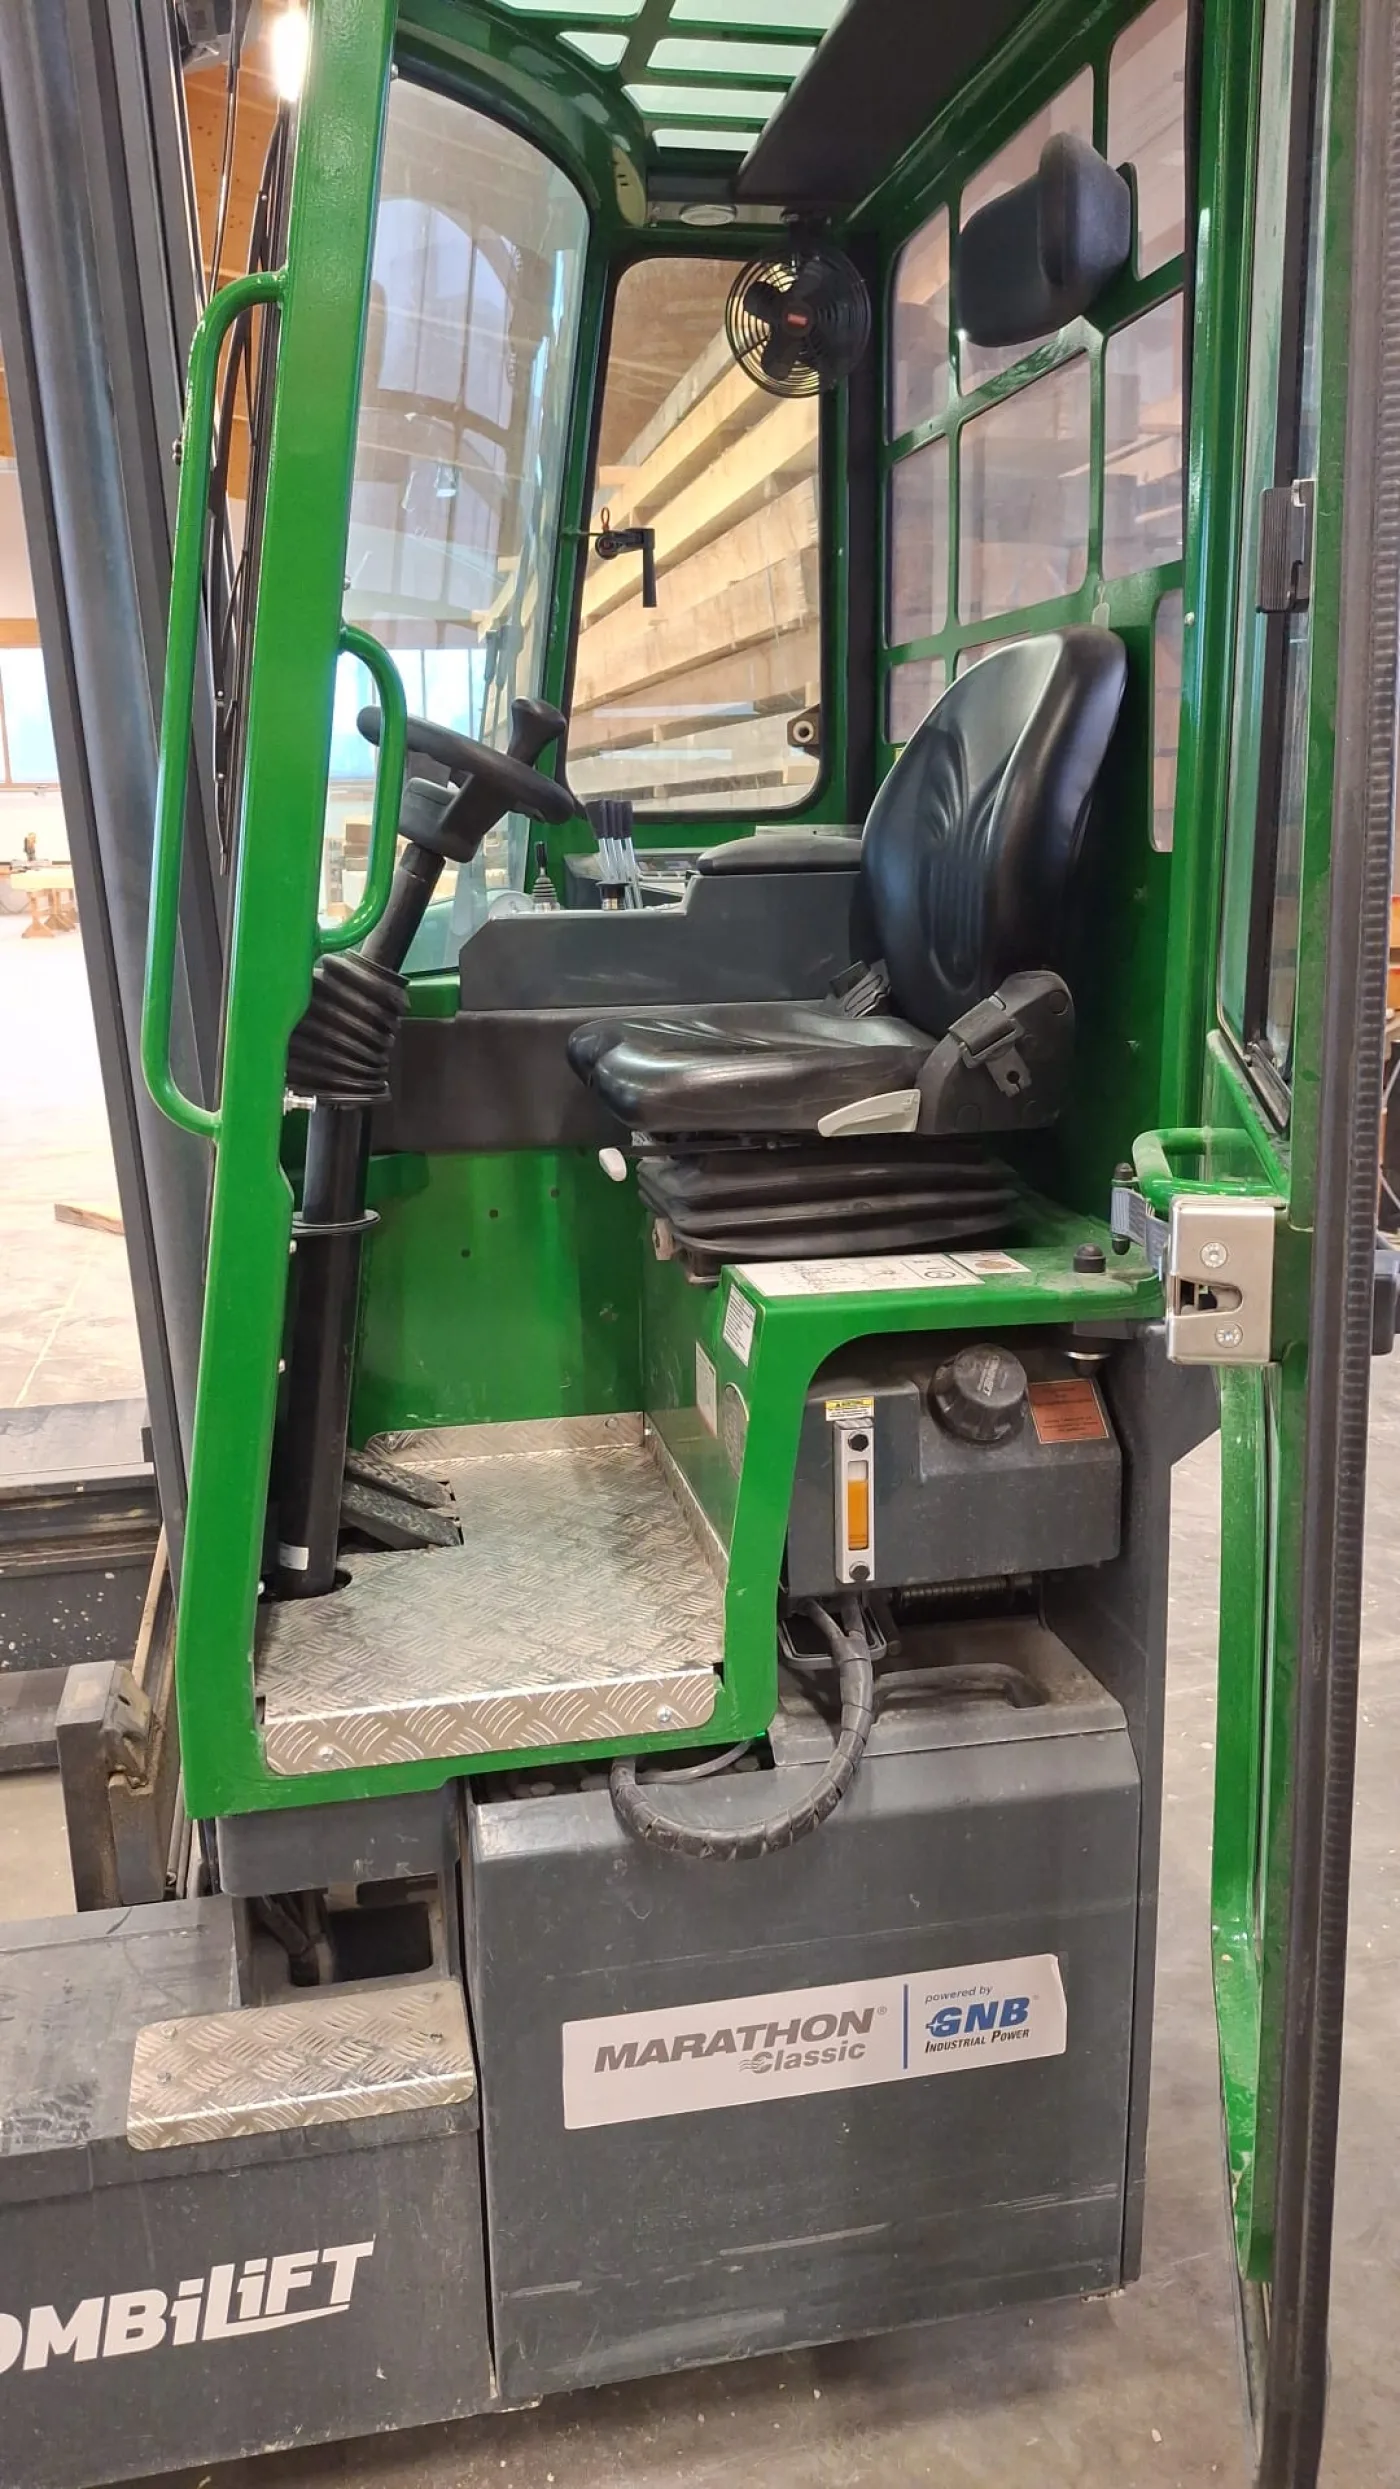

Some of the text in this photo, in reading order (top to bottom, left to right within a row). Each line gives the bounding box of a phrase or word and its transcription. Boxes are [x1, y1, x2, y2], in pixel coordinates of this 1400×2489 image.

[925, 1985, 993, 2004] powered by
[926, 1997, 1030, 2038] GNB
[924, 2029, 1030, 2053] INDUSTRIAL POWER
[742, 2039, 866, 2075] Classic
